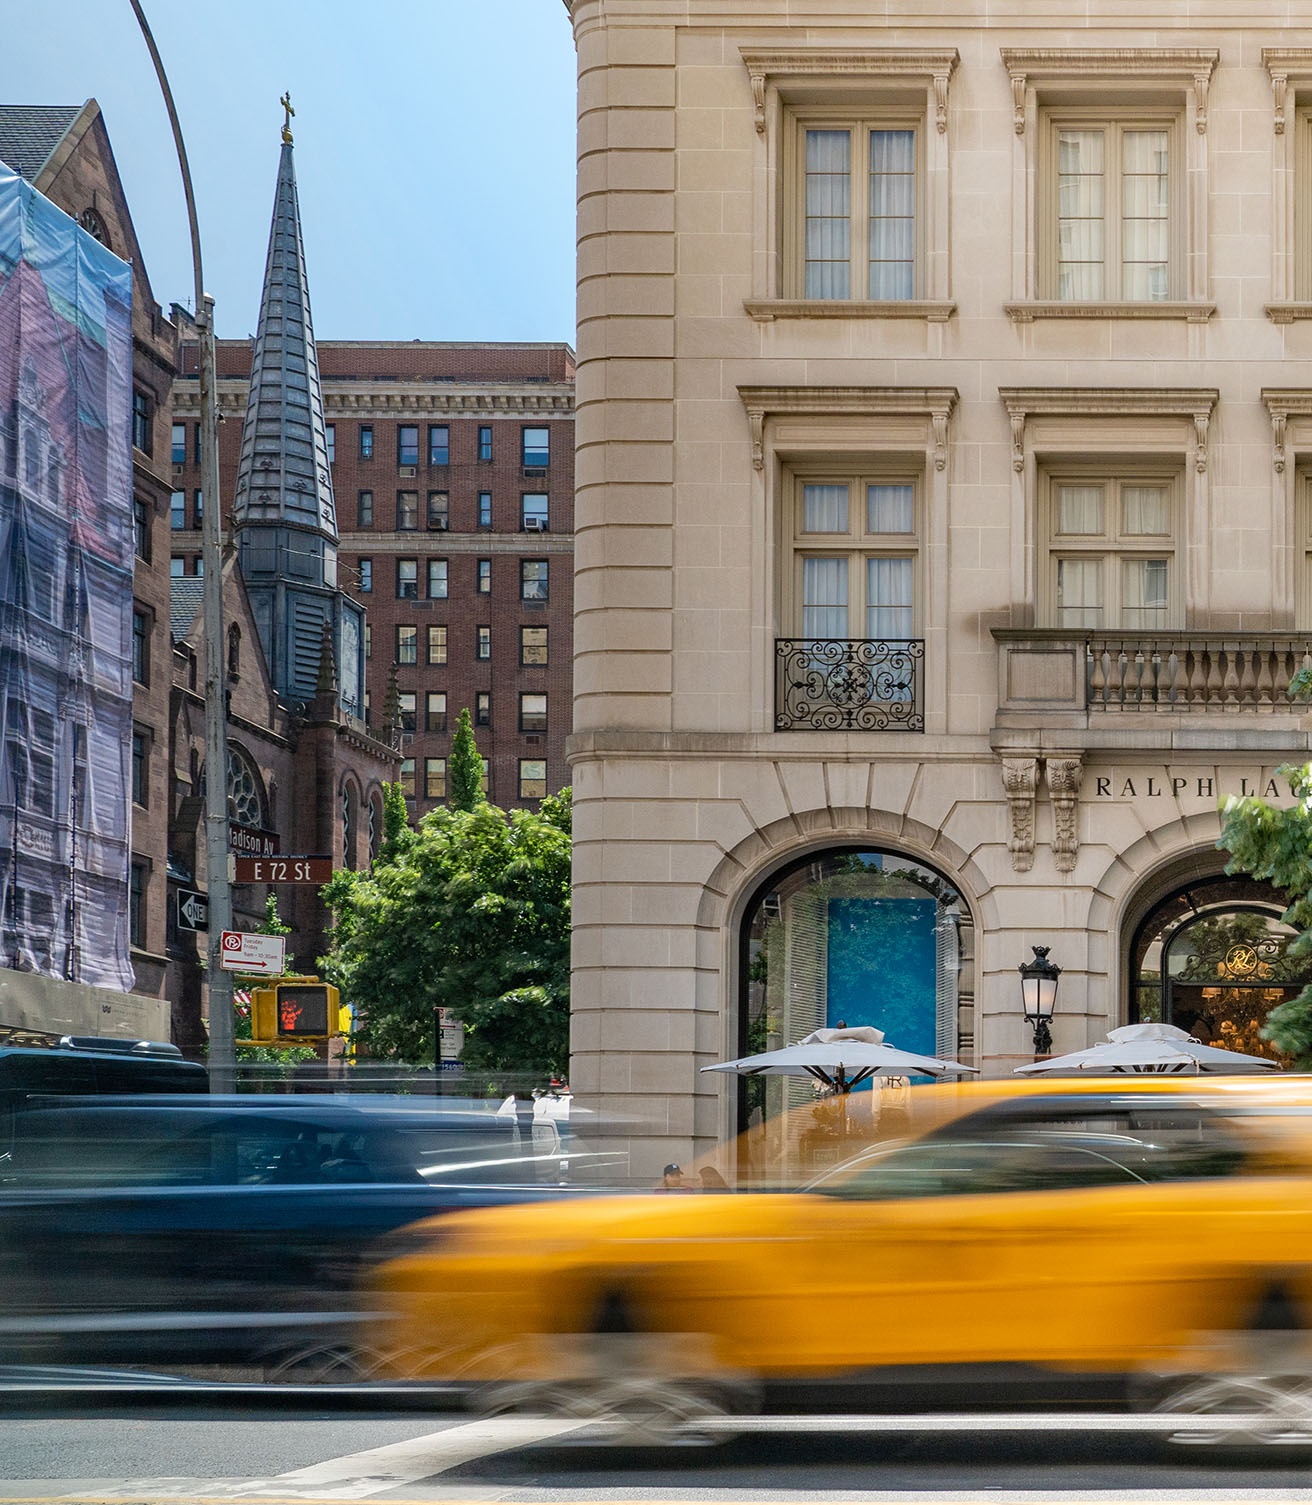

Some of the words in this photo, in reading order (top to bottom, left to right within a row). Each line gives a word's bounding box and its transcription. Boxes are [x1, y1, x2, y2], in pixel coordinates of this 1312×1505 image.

[1095, 777, 1213, 797] RALPH
[229, 827, 261, 853] adison
[263, 838, 274, 855] Av
[254, 862, 263, 880] E
[269, 862, 287, 880] 72
[294, 862, 311, 880] St
[187, 903, 204, 921] ONE
